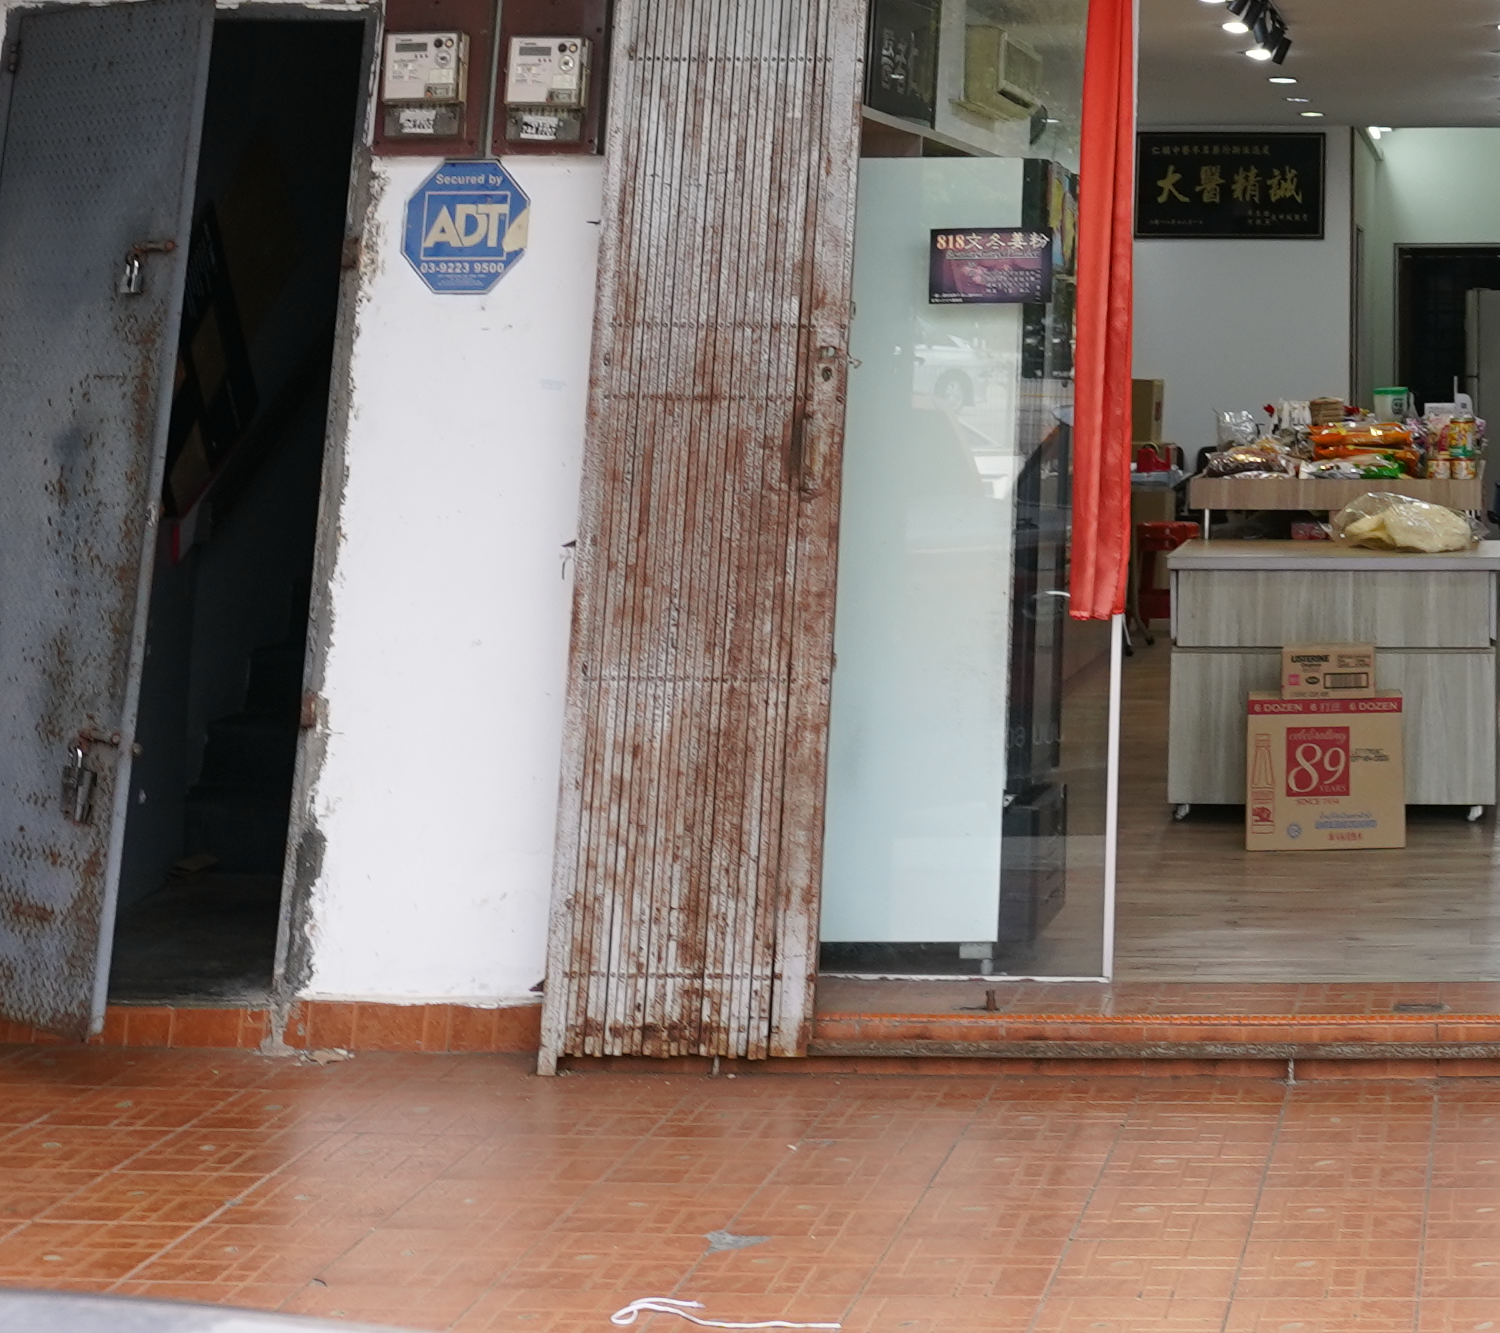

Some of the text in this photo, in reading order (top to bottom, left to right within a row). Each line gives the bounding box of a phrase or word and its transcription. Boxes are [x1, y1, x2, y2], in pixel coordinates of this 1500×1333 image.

[435, 173, 503, 187] Secured by
[423, 203, 509, 247] ADT
[420, 262, 505, 274] 03-9223 9500
[1263, 703, 1303, 713] DOZEN
[1358, 702, 1398, 711] DOZEN
[1288, 742, 1347, 793] 89
